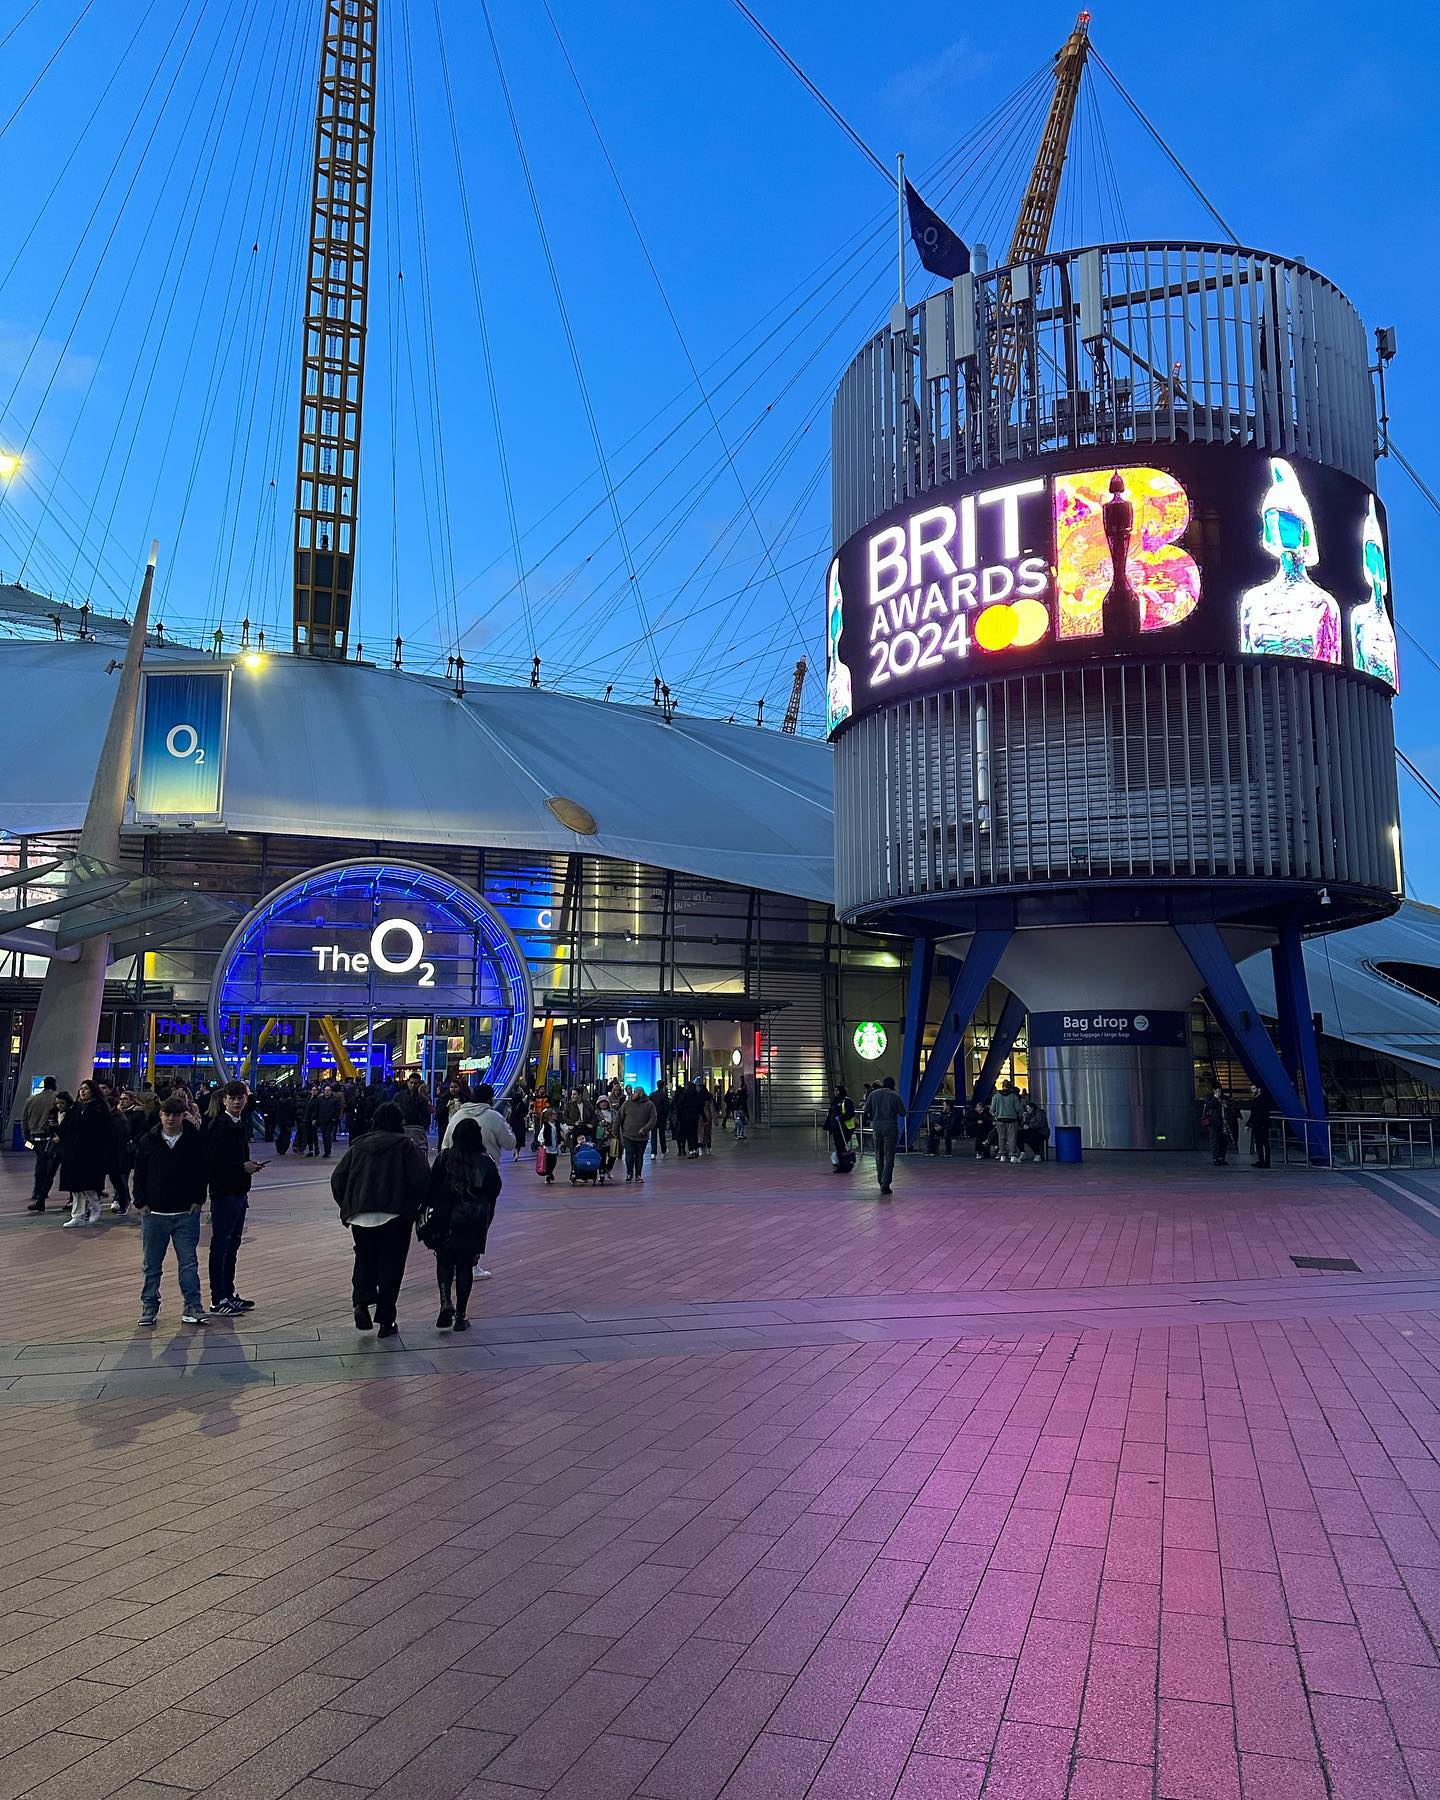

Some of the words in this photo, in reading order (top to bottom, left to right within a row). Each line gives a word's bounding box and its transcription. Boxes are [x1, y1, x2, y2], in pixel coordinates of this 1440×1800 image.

[868, 477, 1046, 606] BRIT
[869, 557, 1049, 641] AWARDS
[869, 613, 972, 685] 2024
[166, 724, 205, 764] O2
[311, 945, 370, 973] The
[370, 918, 436, 987] O2
[158, 1018, 192, 1036] The
[616, 1018, 633, 1048] O2
[1063, 1016, 1089, 1031] Bag
[1093, 1015, 1129, 1031] drop
[1080, 1032, 1101, 1040] luggage
